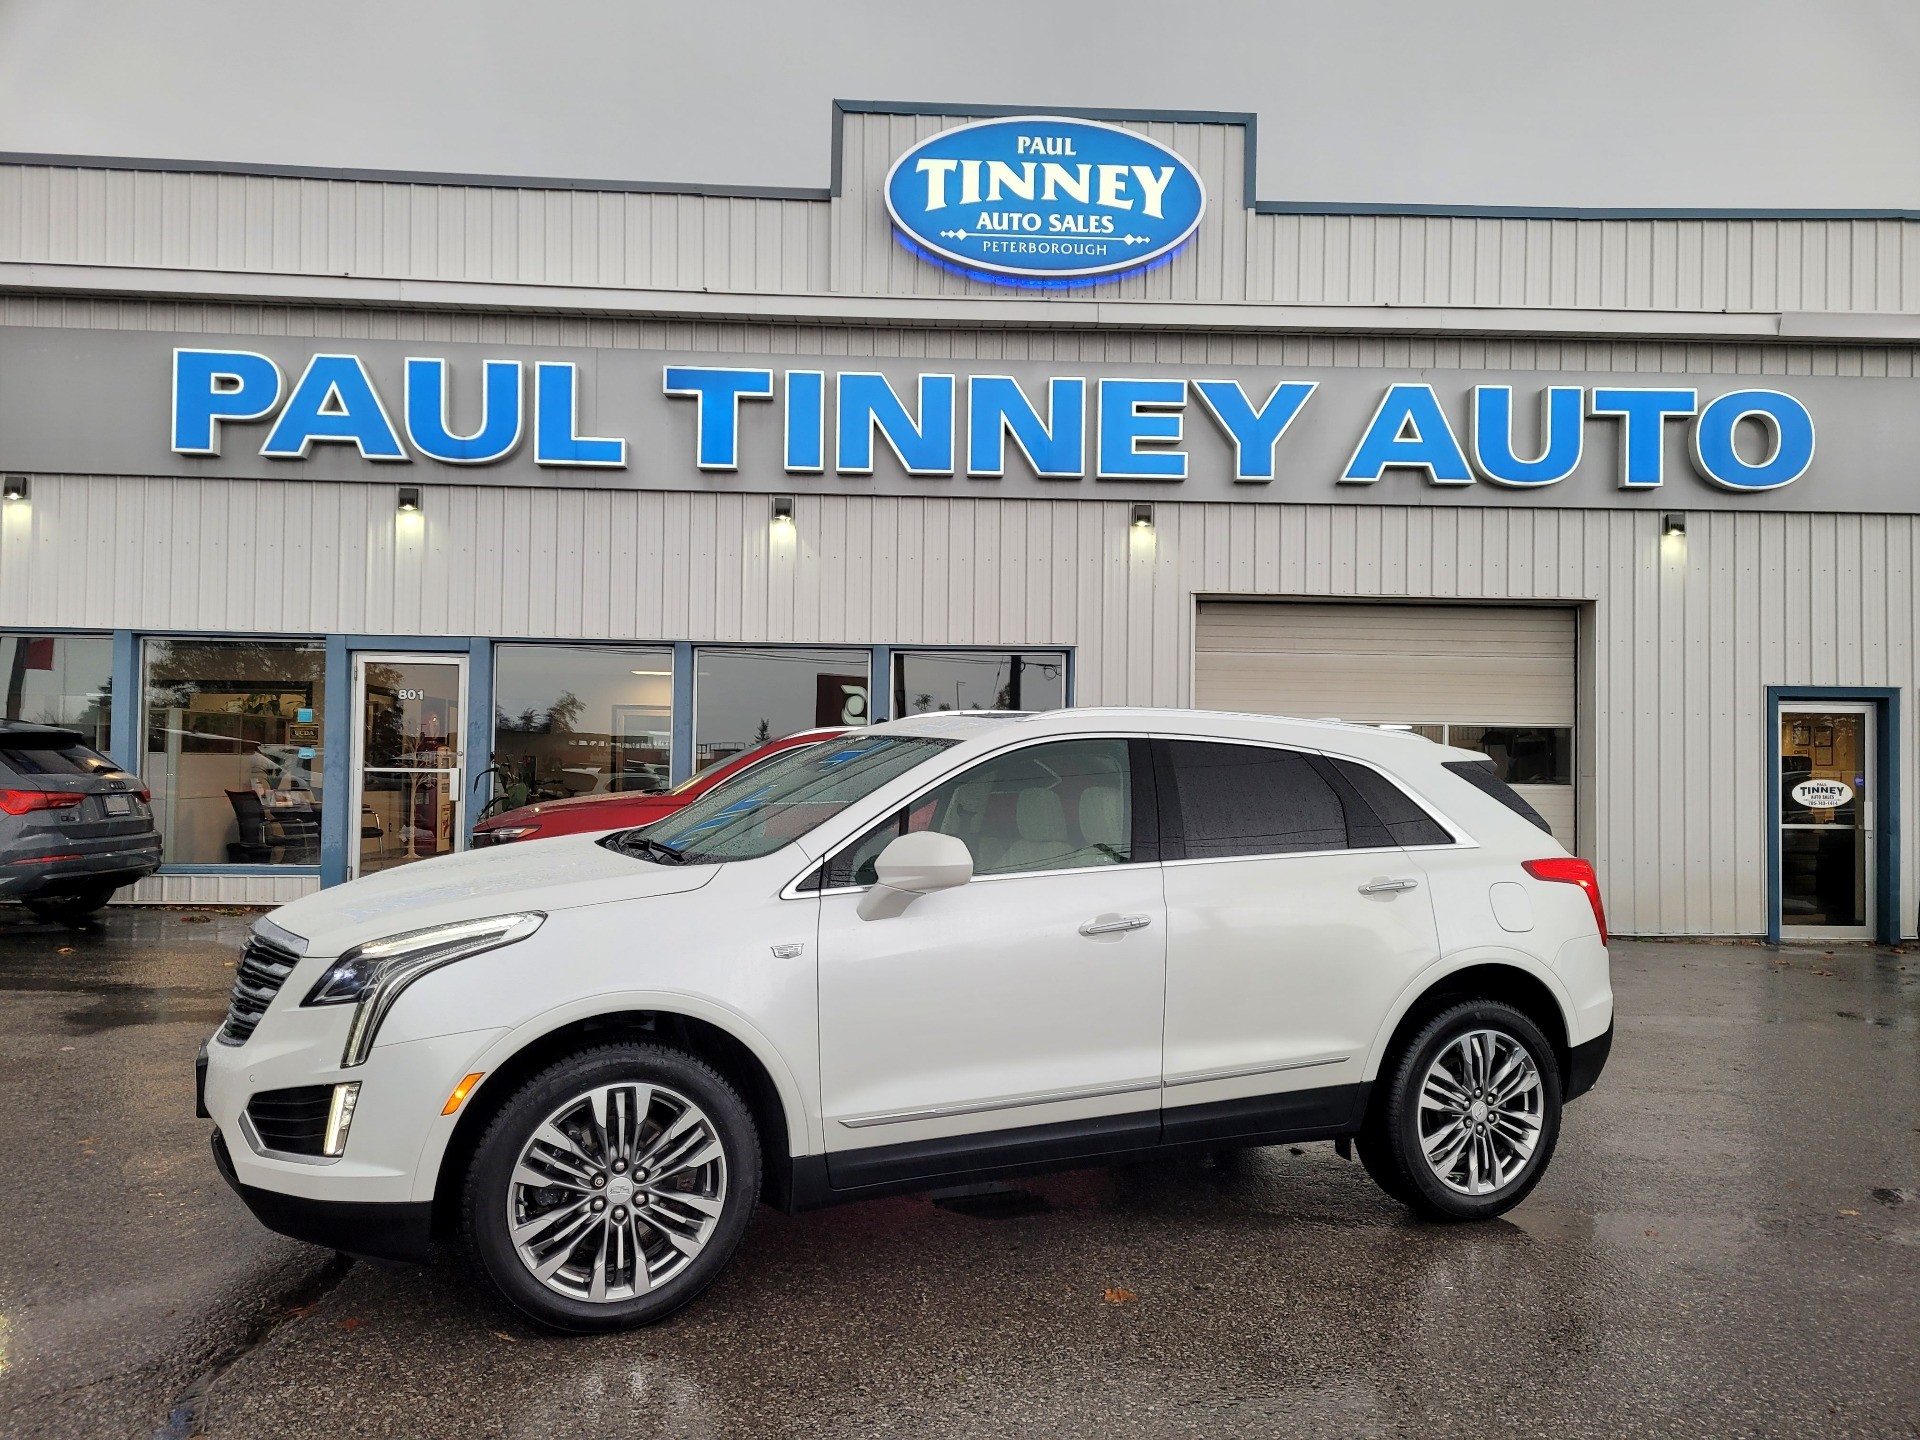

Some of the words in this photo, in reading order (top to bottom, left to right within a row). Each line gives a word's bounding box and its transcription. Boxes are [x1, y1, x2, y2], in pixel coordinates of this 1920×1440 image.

[1017, 135, 1076, 156] PAUL
[915, 158, 1176, 219] TINNEY
[976, 212, 1041, 231] AUTO
[1048, 214, 1114, 234] SALES
[983, 240, 1107, 256] PETERBOROUGH
[171, 347, 627, 468] PAUL
[662, 365, 1321, 484] TINNEY
[1337, 382, 1816, 492] AUTO
[398, 689, 425, 700] 801
[1800, 786, 1845, 797] TINNEY
